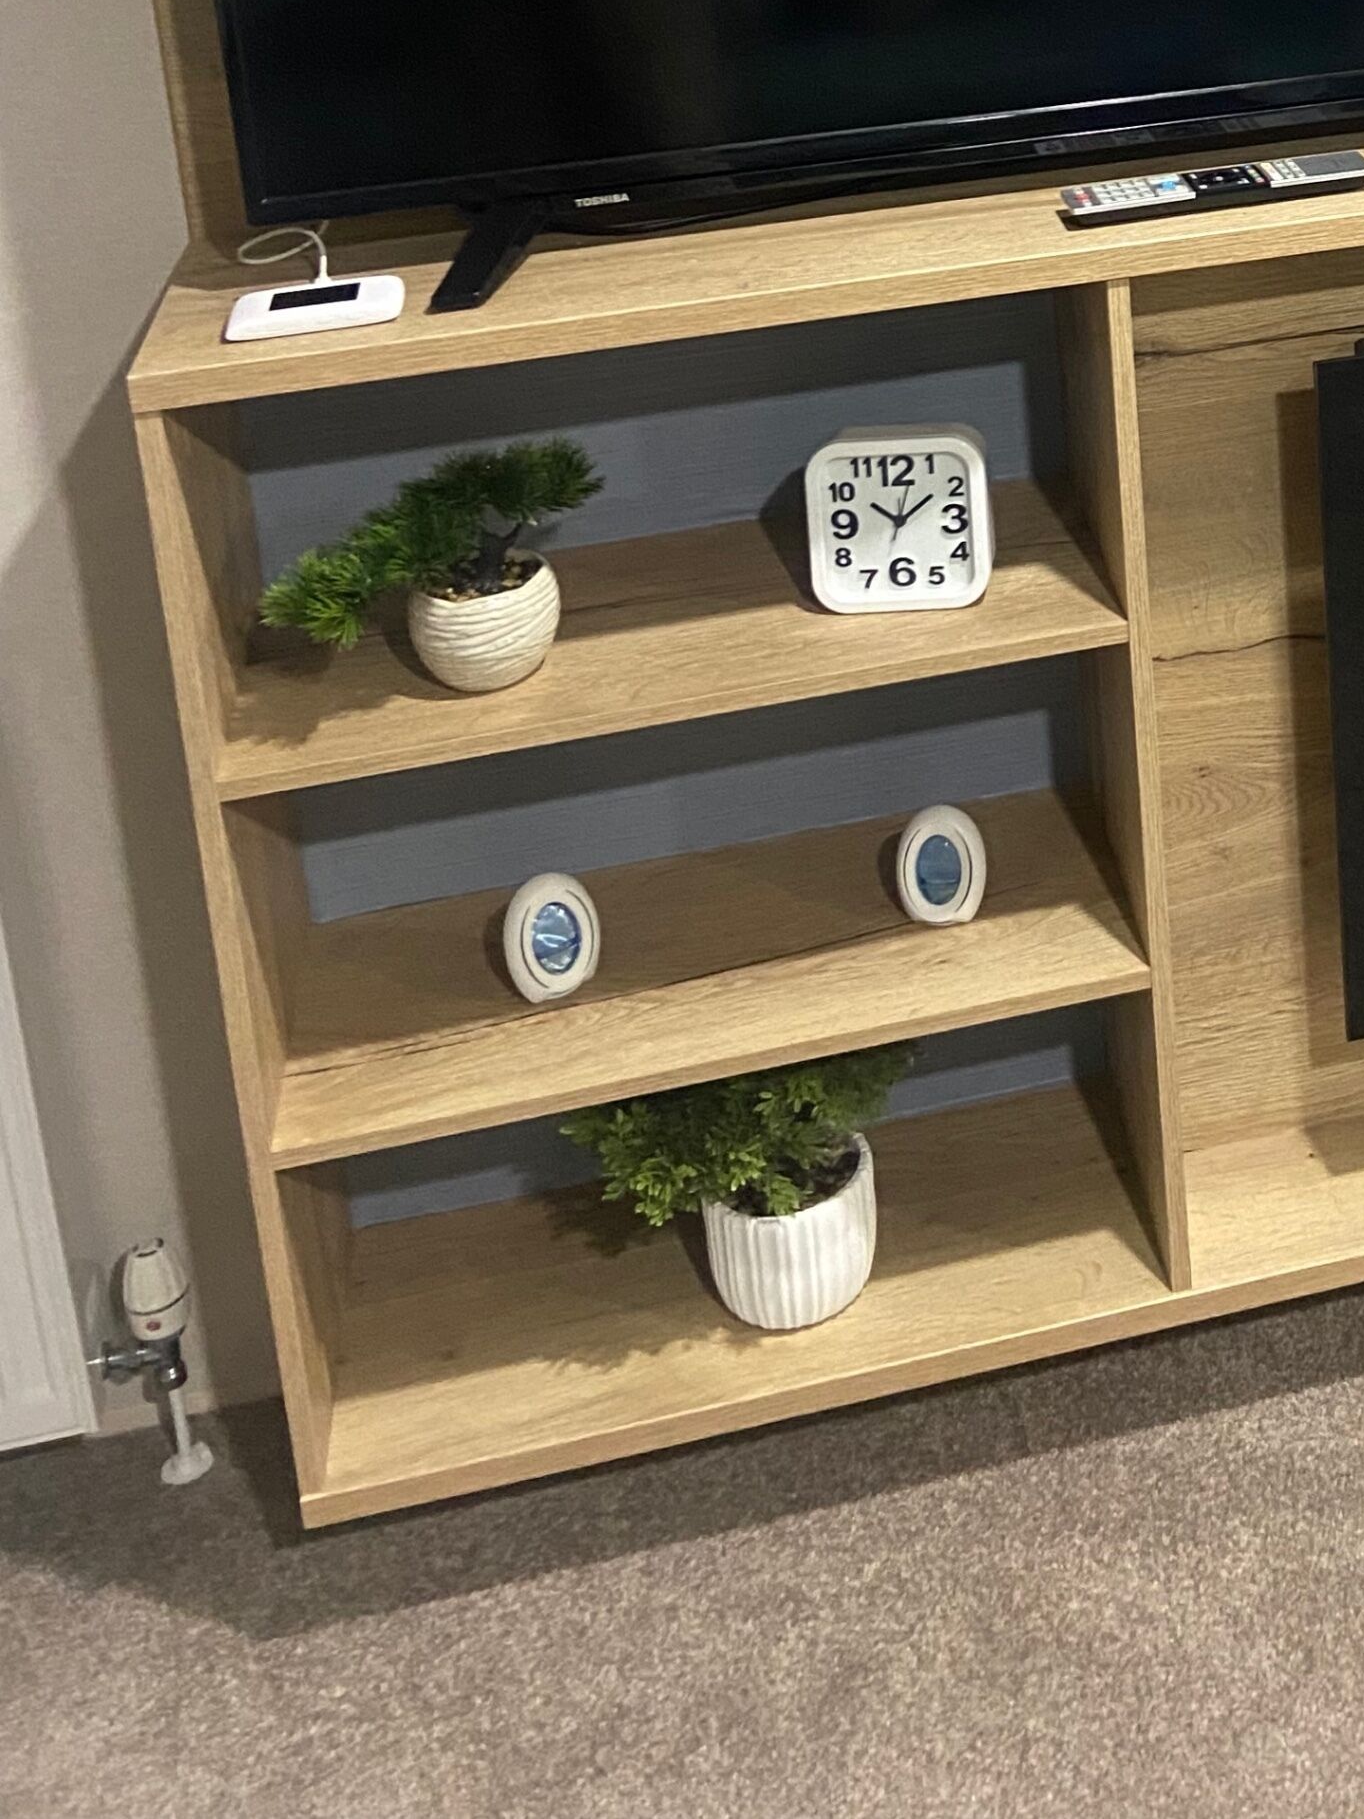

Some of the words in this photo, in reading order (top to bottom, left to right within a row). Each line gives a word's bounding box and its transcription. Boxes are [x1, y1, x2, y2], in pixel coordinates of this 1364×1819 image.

[574, 192, 630, 207] TOSHIBA
[849, 456, 872, 478] 11
[877, 454, 915, 487] 12
[924, 453, 935, 474] 1
[828, 481, 856, 502] 10
[947, 476, 965, 497] 2
[831, 509, 859, 540] 9
[941, 503, 969, 534] 3
[834, 547, 853, 568] 8
[949, 541, 970, 561] 4
[859, 569, 879, 589] 7
[888, 557, 917, 587] 6
[928, 566, 946, 585] 5
